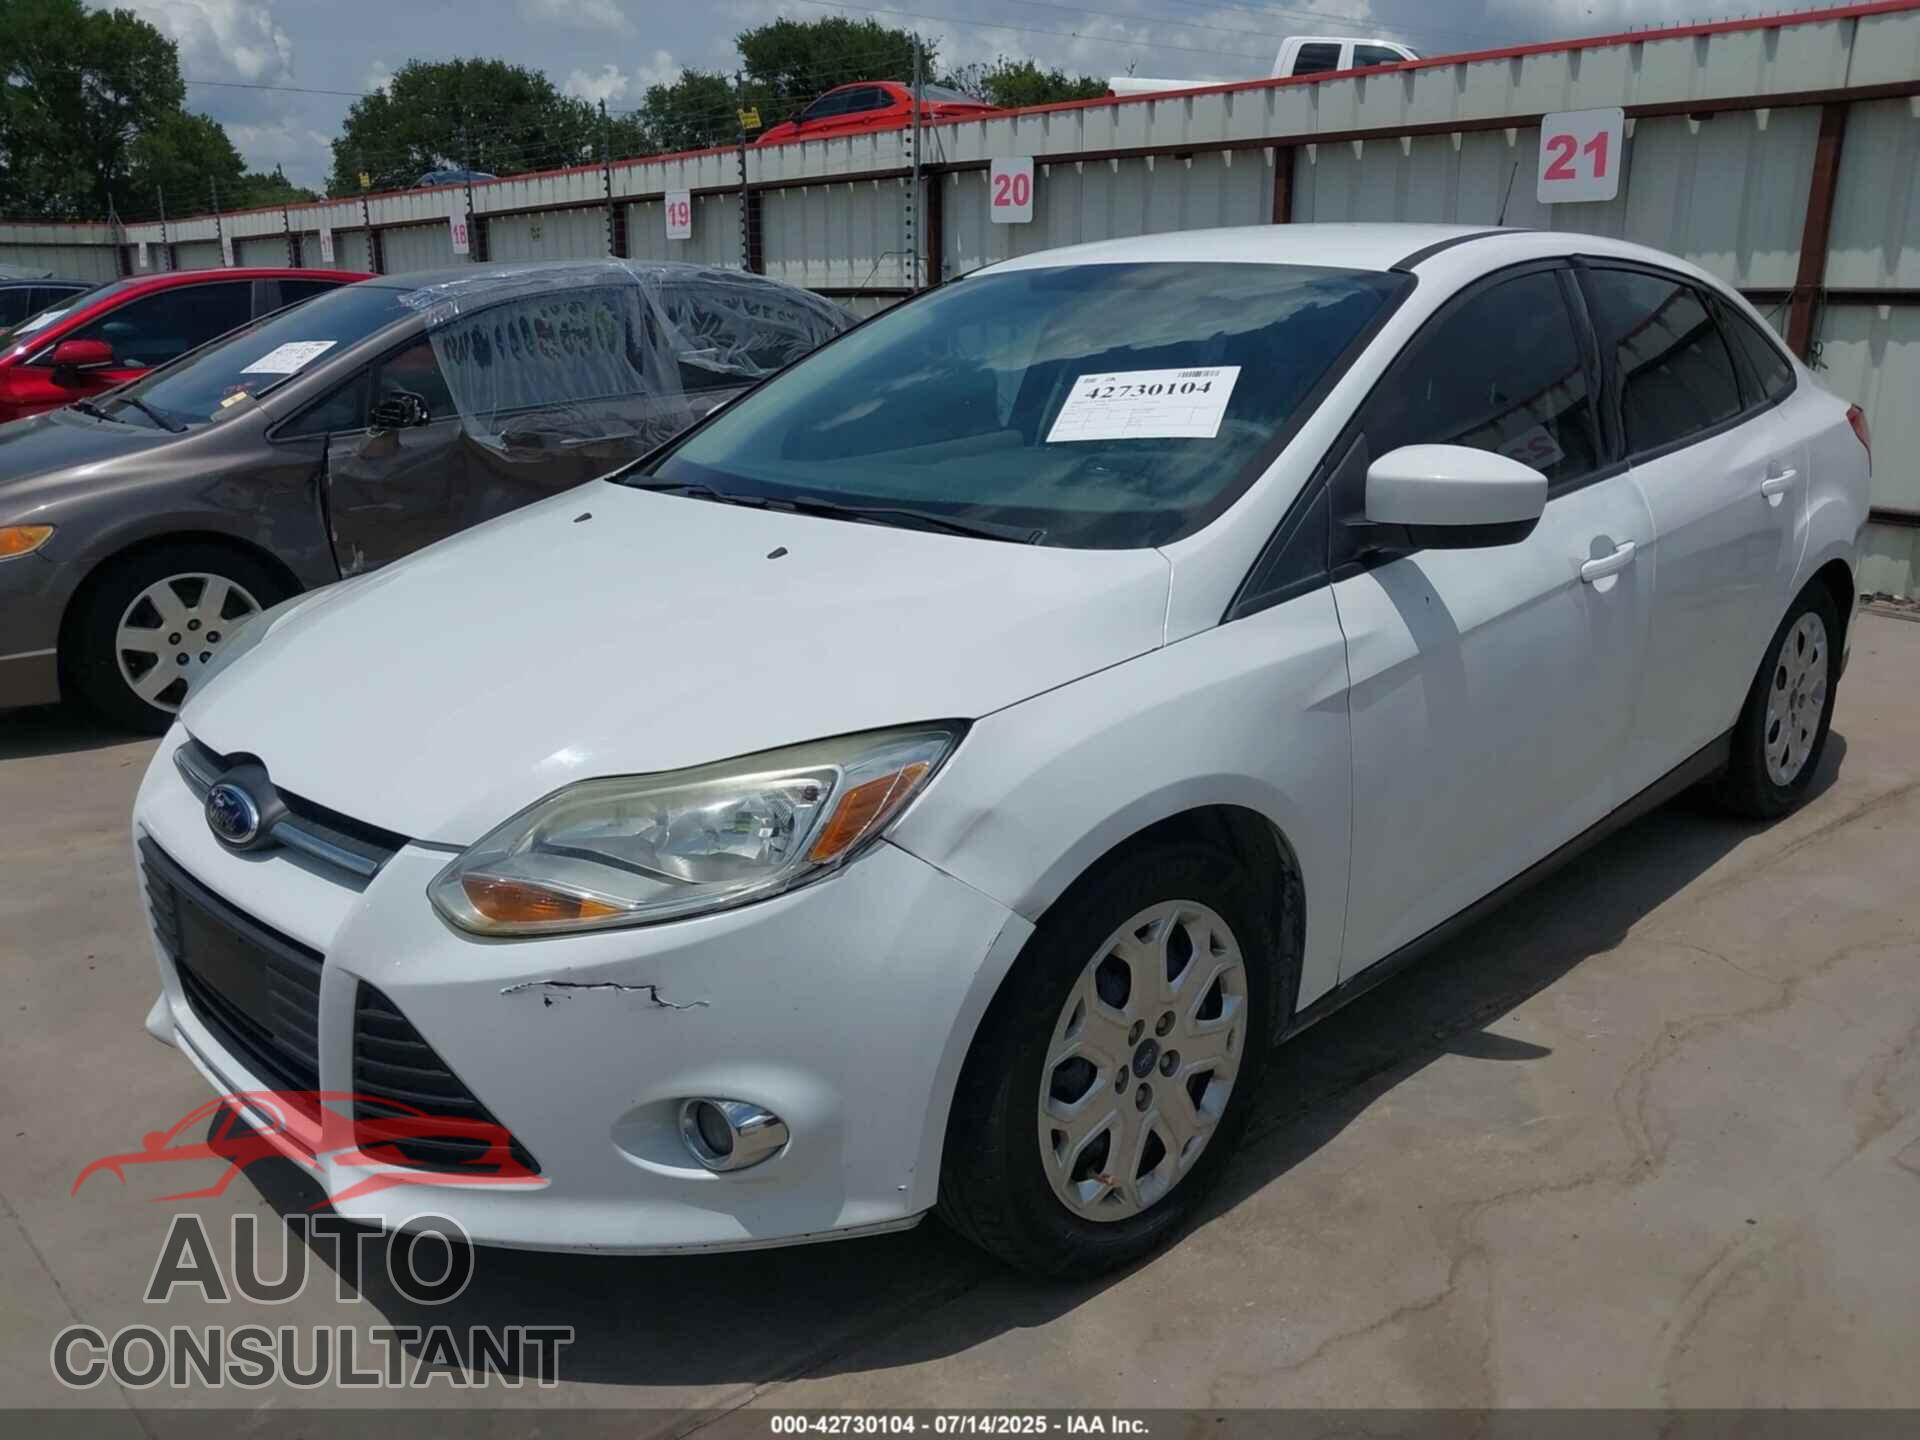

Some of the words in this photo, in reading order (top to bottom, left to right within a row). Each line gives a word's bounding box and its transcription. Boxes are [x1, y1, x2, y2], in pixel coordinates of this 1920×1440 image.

[1543, 131, 1610, 180] 21
[993, 173, 1031, 207] 20
[667, 201, 691, 227] 19
[1085, 381, 1213, 400] 42730104
